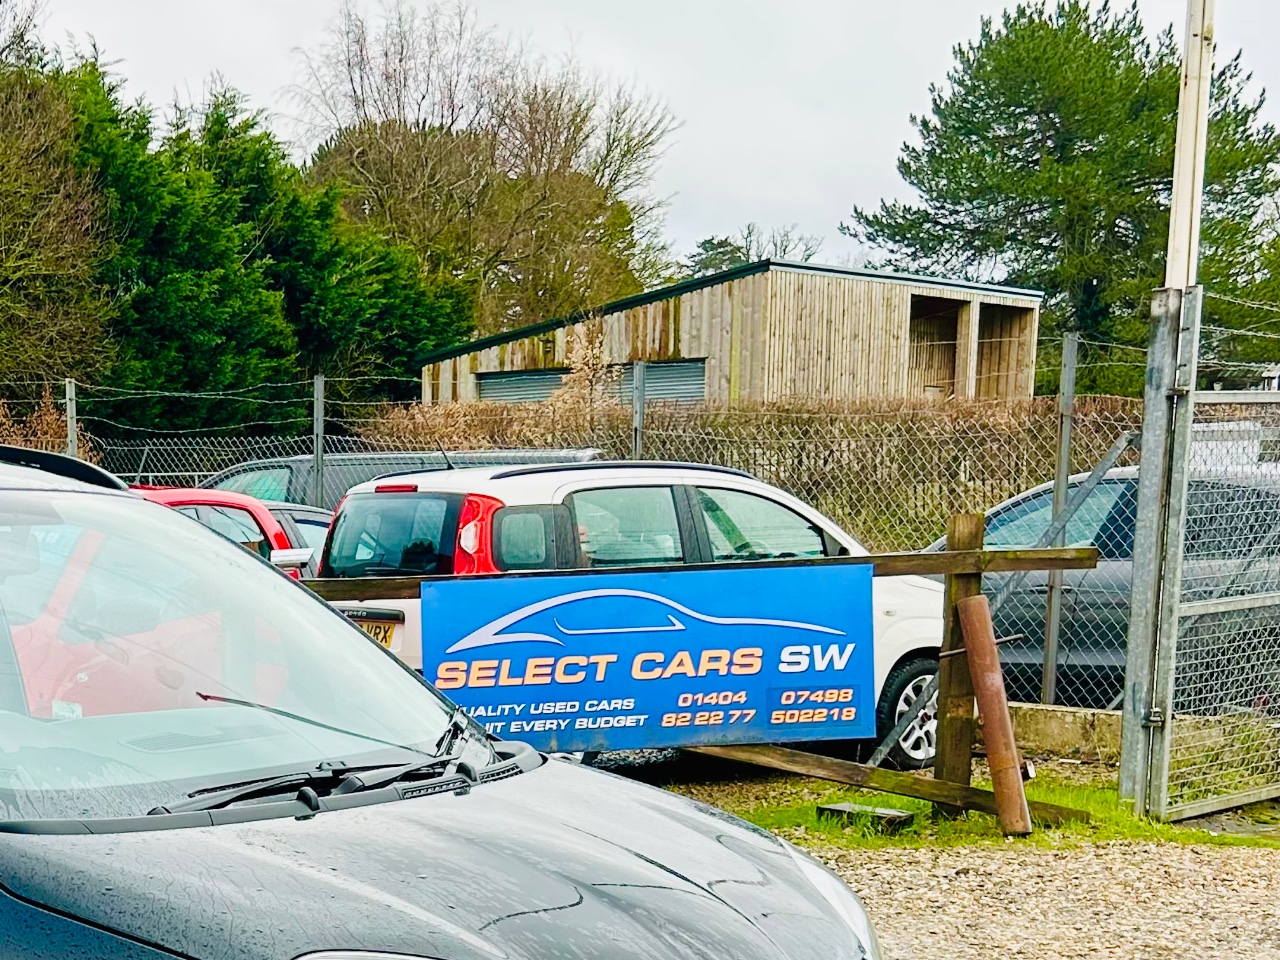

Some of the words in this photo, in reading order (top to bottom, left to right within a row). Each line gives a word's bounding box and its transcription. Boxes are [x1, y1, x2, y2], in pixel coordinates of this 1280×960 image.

[434, 653, 618, 691] SELECT
[631, 647, 764, 681] CARS
[778, 643, 857, 675] SW
[677, 690, 748, 708] 01404
[780, 688, 854, 706] 07498
[457, 703, 525, 718] UALITY
[529, 701, 580, 715] USED
[584, 698, 635, 712] CARS
[770, 707, 857, 724] 502218
[510, 719, 571, 733] EVERY
[574, 714, 649, 730] BUDGET
